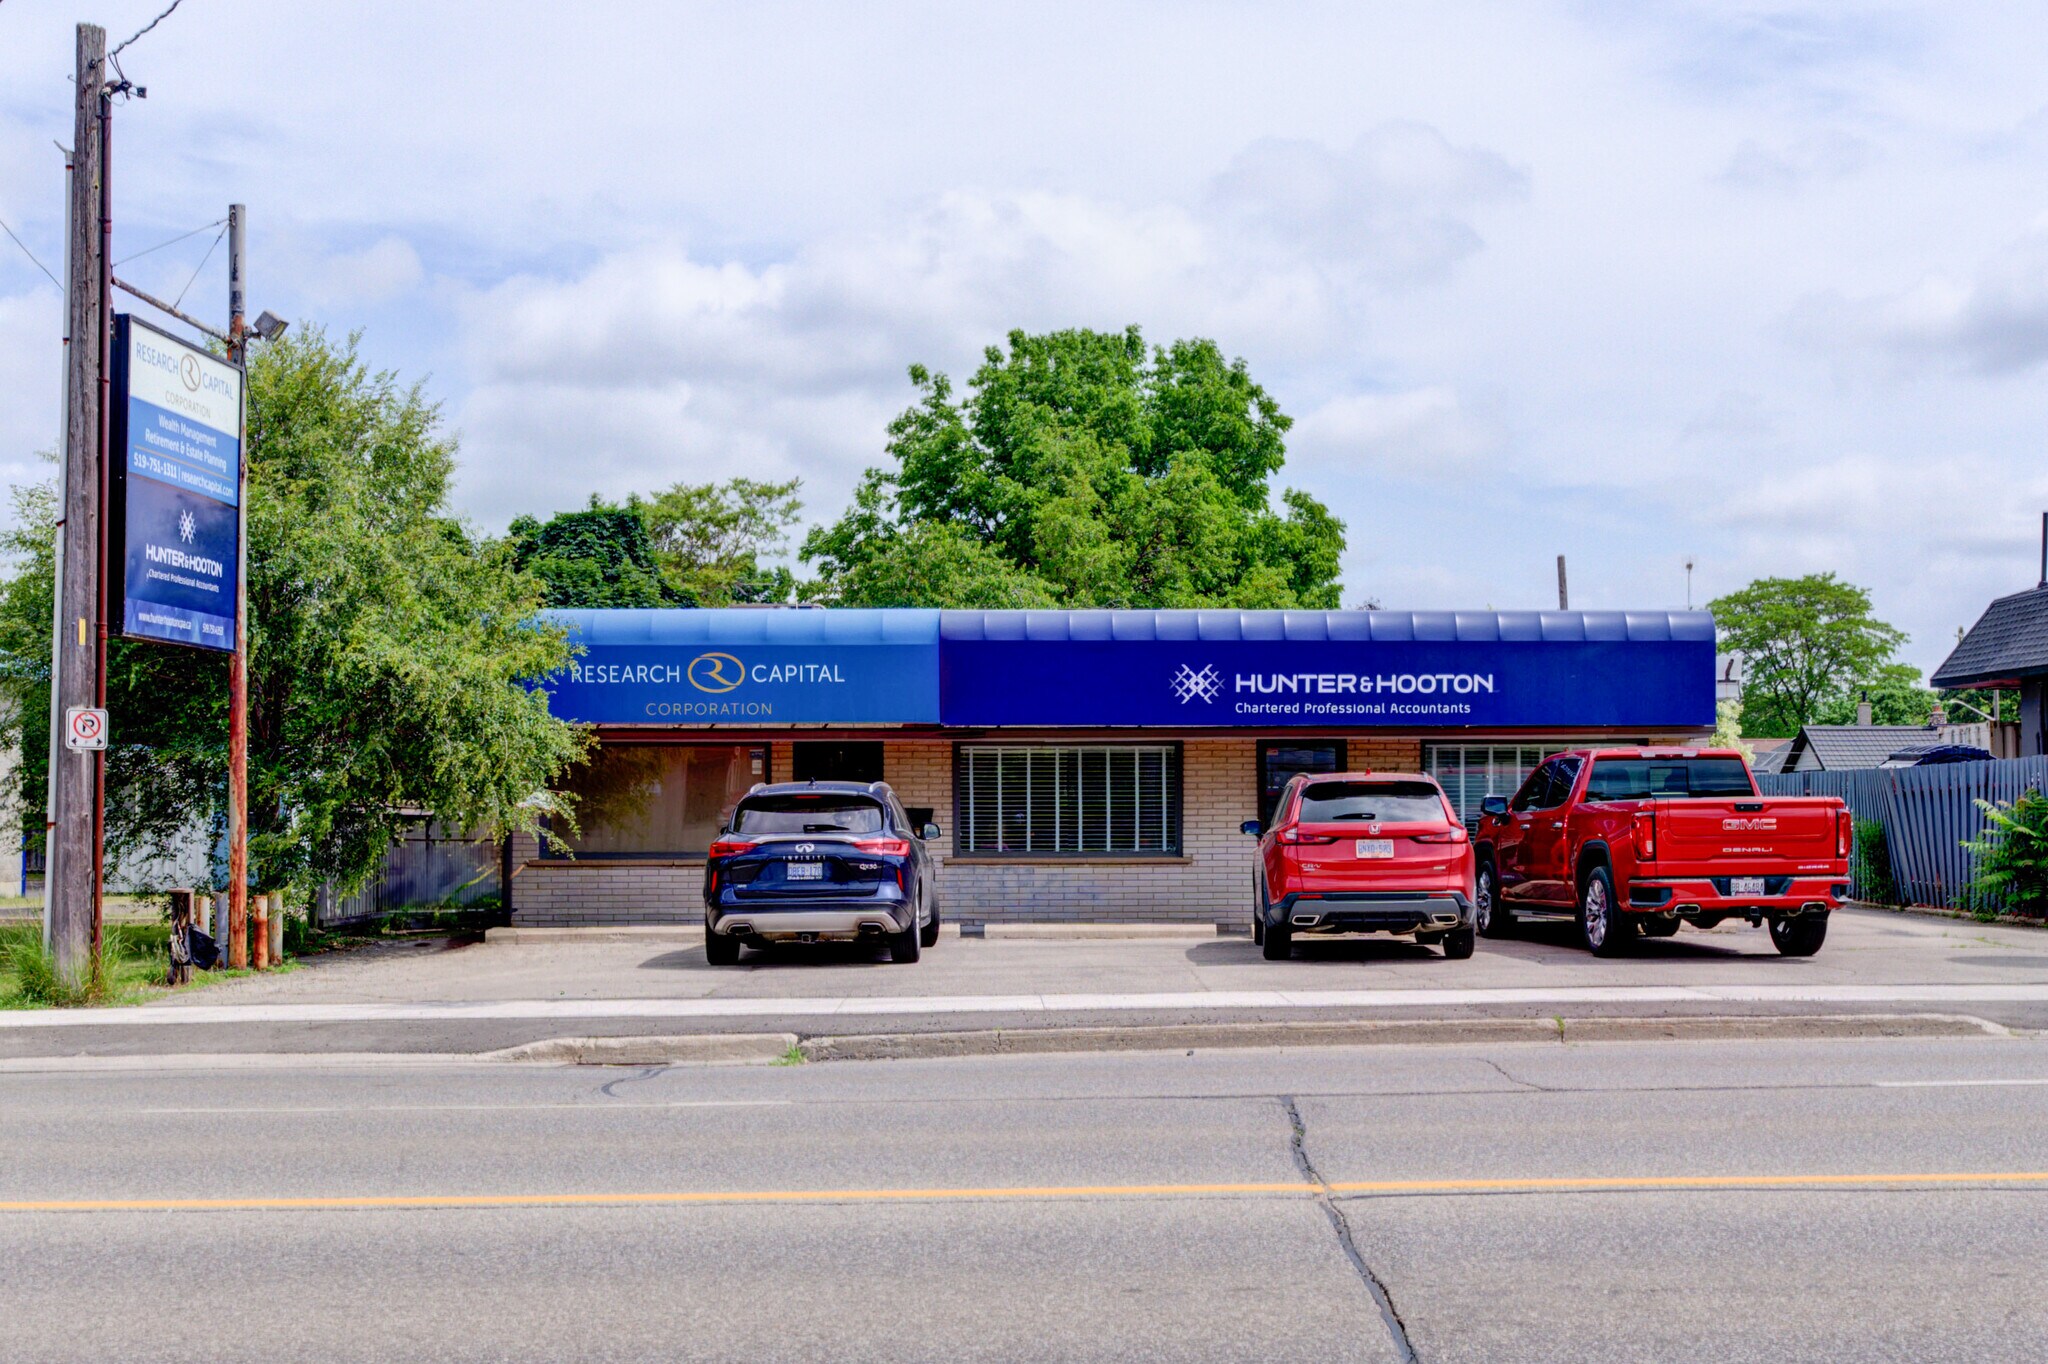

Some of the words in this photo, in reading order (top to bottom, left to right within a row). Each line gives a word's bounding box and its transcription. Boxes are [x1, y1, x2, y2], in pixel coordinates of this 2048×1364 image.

[136, 342, 179, 375] RESEARCH
[202, 373, 234, 400] CAPITAL
[165, 390, 211, 419] CORPORATION
[158, 414, 180, 434] Wealth
[180, 421, 217, 448] Management
[145, 428, 180, 453] Retirement
[180, 441, 185, 454] &
[186, 444, 203, 461] Estate
[203, 449, 227, 473] Planning
[133, 452, 178, 480] 519-751-1311
[181, 468, 234, 498] researchcapital.com
[148, 568, 170, 582] Chartered
[170, 573, 196, 587] Professional
[196, 579, 220, 593] Accountants
[571, 665, 680, 683] RESEARCH
[751, 664, 845, 683] CAPITAL
[645, 702, 772, 716] CORPORATION
[1235, 702, 1300, 714] Chartered
[1304, 702, 1385, 714] Professional
[1390, 702, 1472, 714] Accountants
[1722, 818, 1777, 831] GMC
